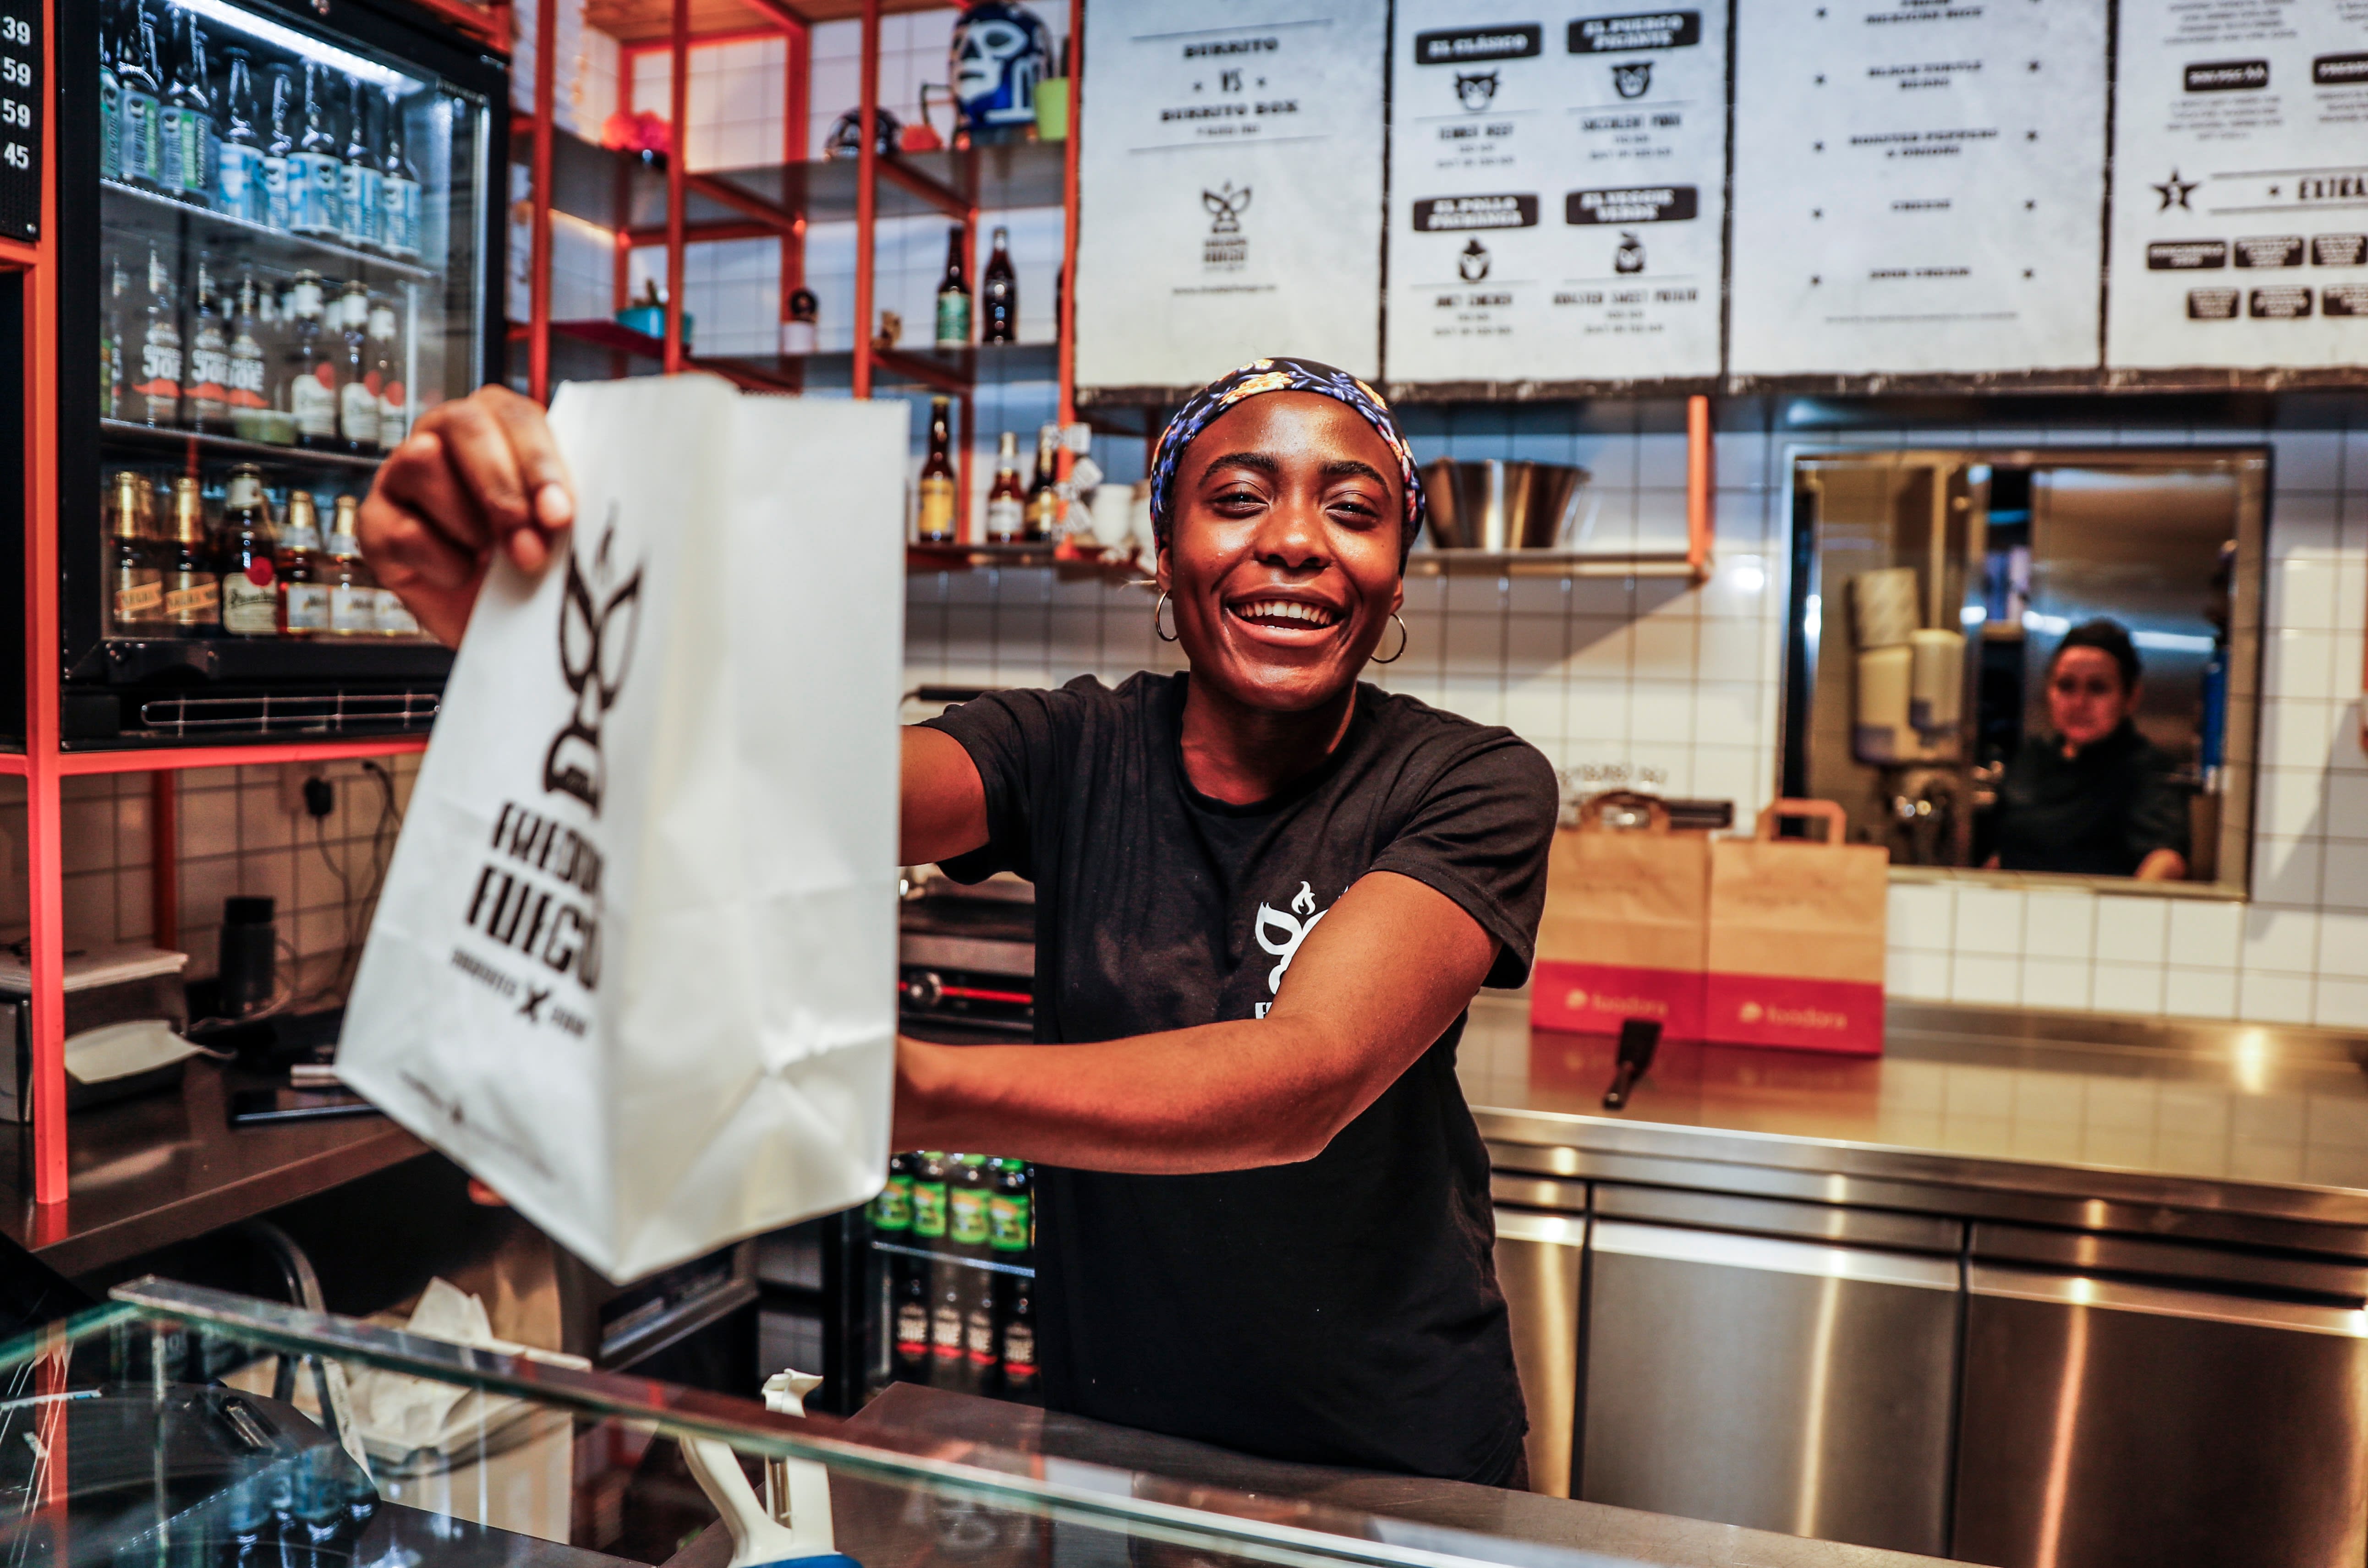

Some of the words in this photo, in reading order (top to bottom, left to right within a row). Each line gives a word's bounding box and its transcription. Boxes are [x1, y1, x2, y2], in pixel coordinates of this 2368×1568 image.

[2, 16, 31, 45] 39
[3, 56, 31, 87] 59
[3, 98, 31, 129] 59
[4, 142, 29, 169] 45
